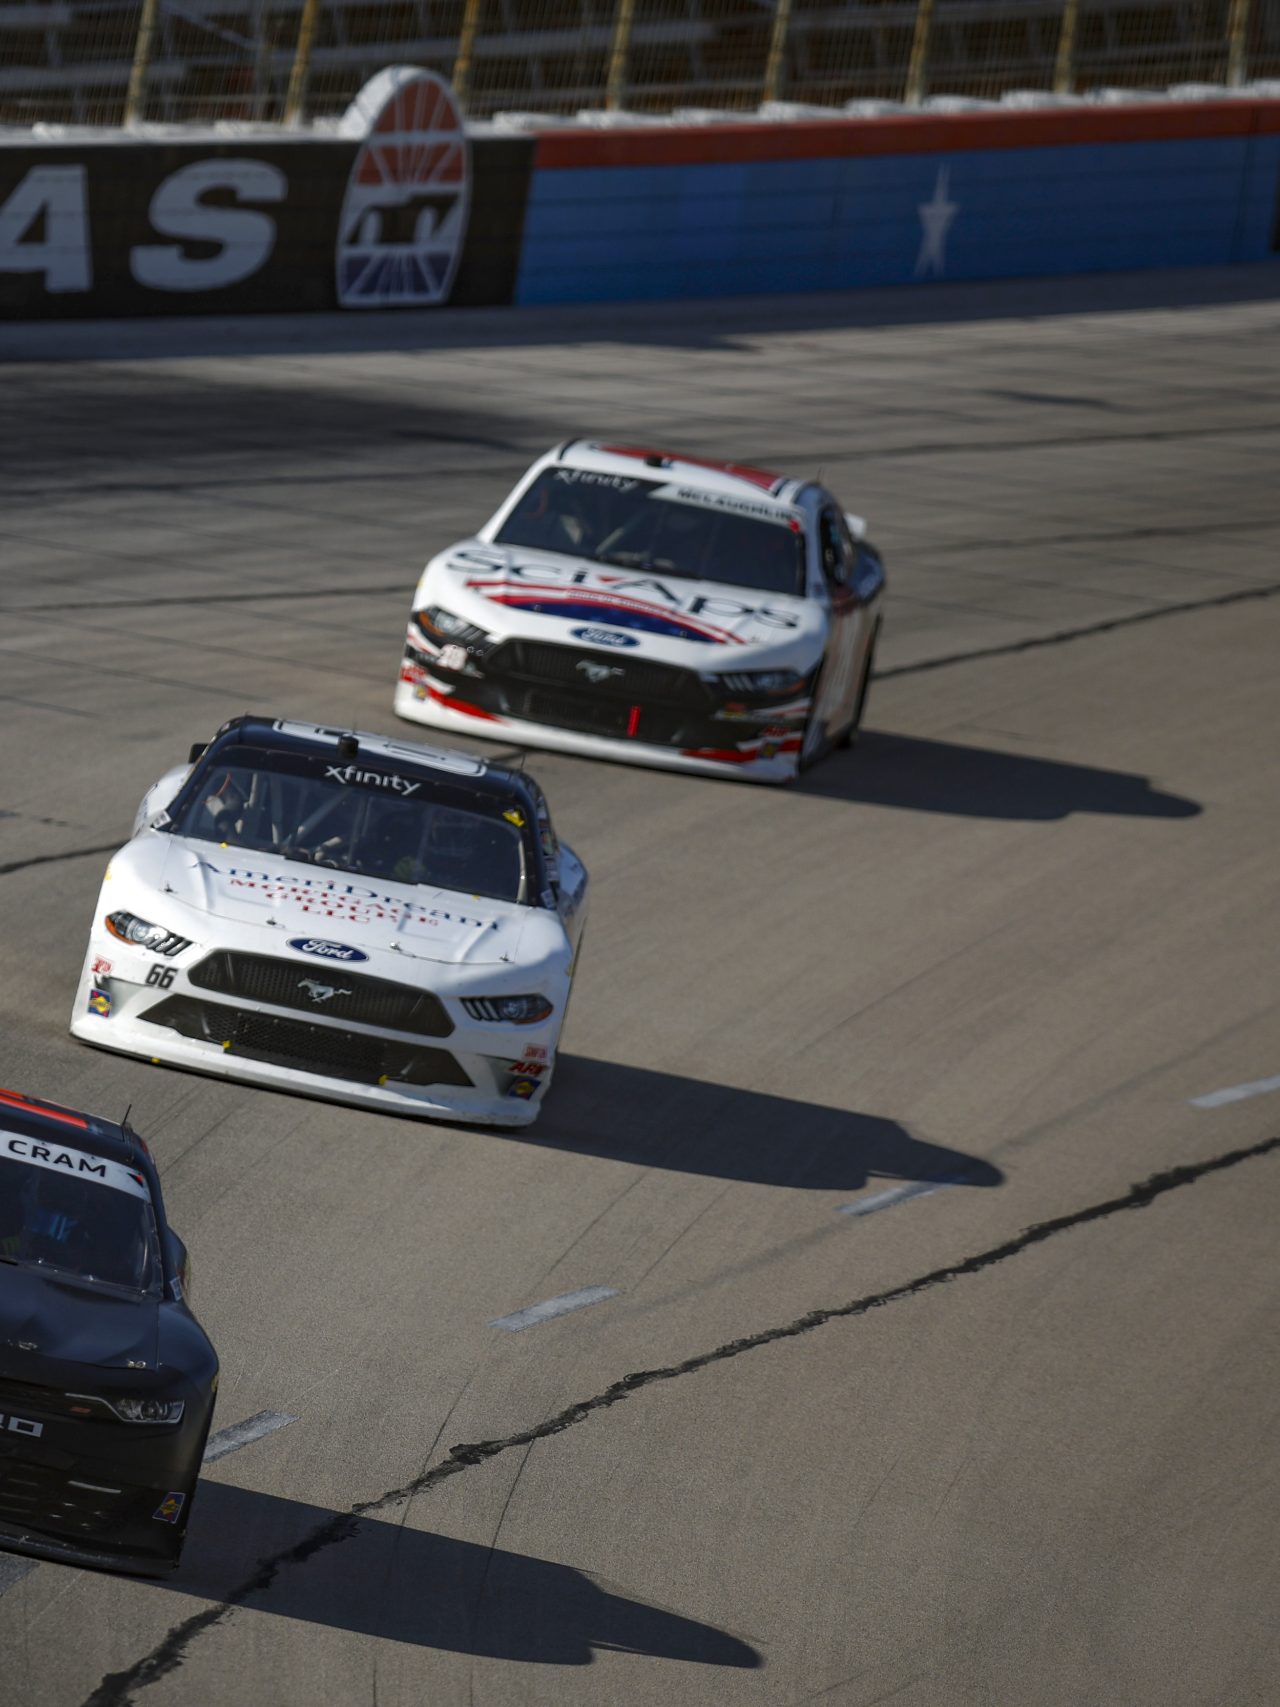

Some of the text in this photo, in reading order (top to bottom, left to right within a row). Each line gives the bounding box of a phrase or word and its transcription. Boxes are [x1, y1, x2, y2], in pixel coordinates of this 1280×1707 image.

[581, 627, 626, 645] Ford
[324, 765, 421, 795] xfinity
[190, 861, 499, 931] AmeriDream
[301, 903, 370, 925] LLC
[302, 939, 354, 960] Ford
[145, 963, 179, 989] 66
[8, 1139, 107, 1178] CRAM
